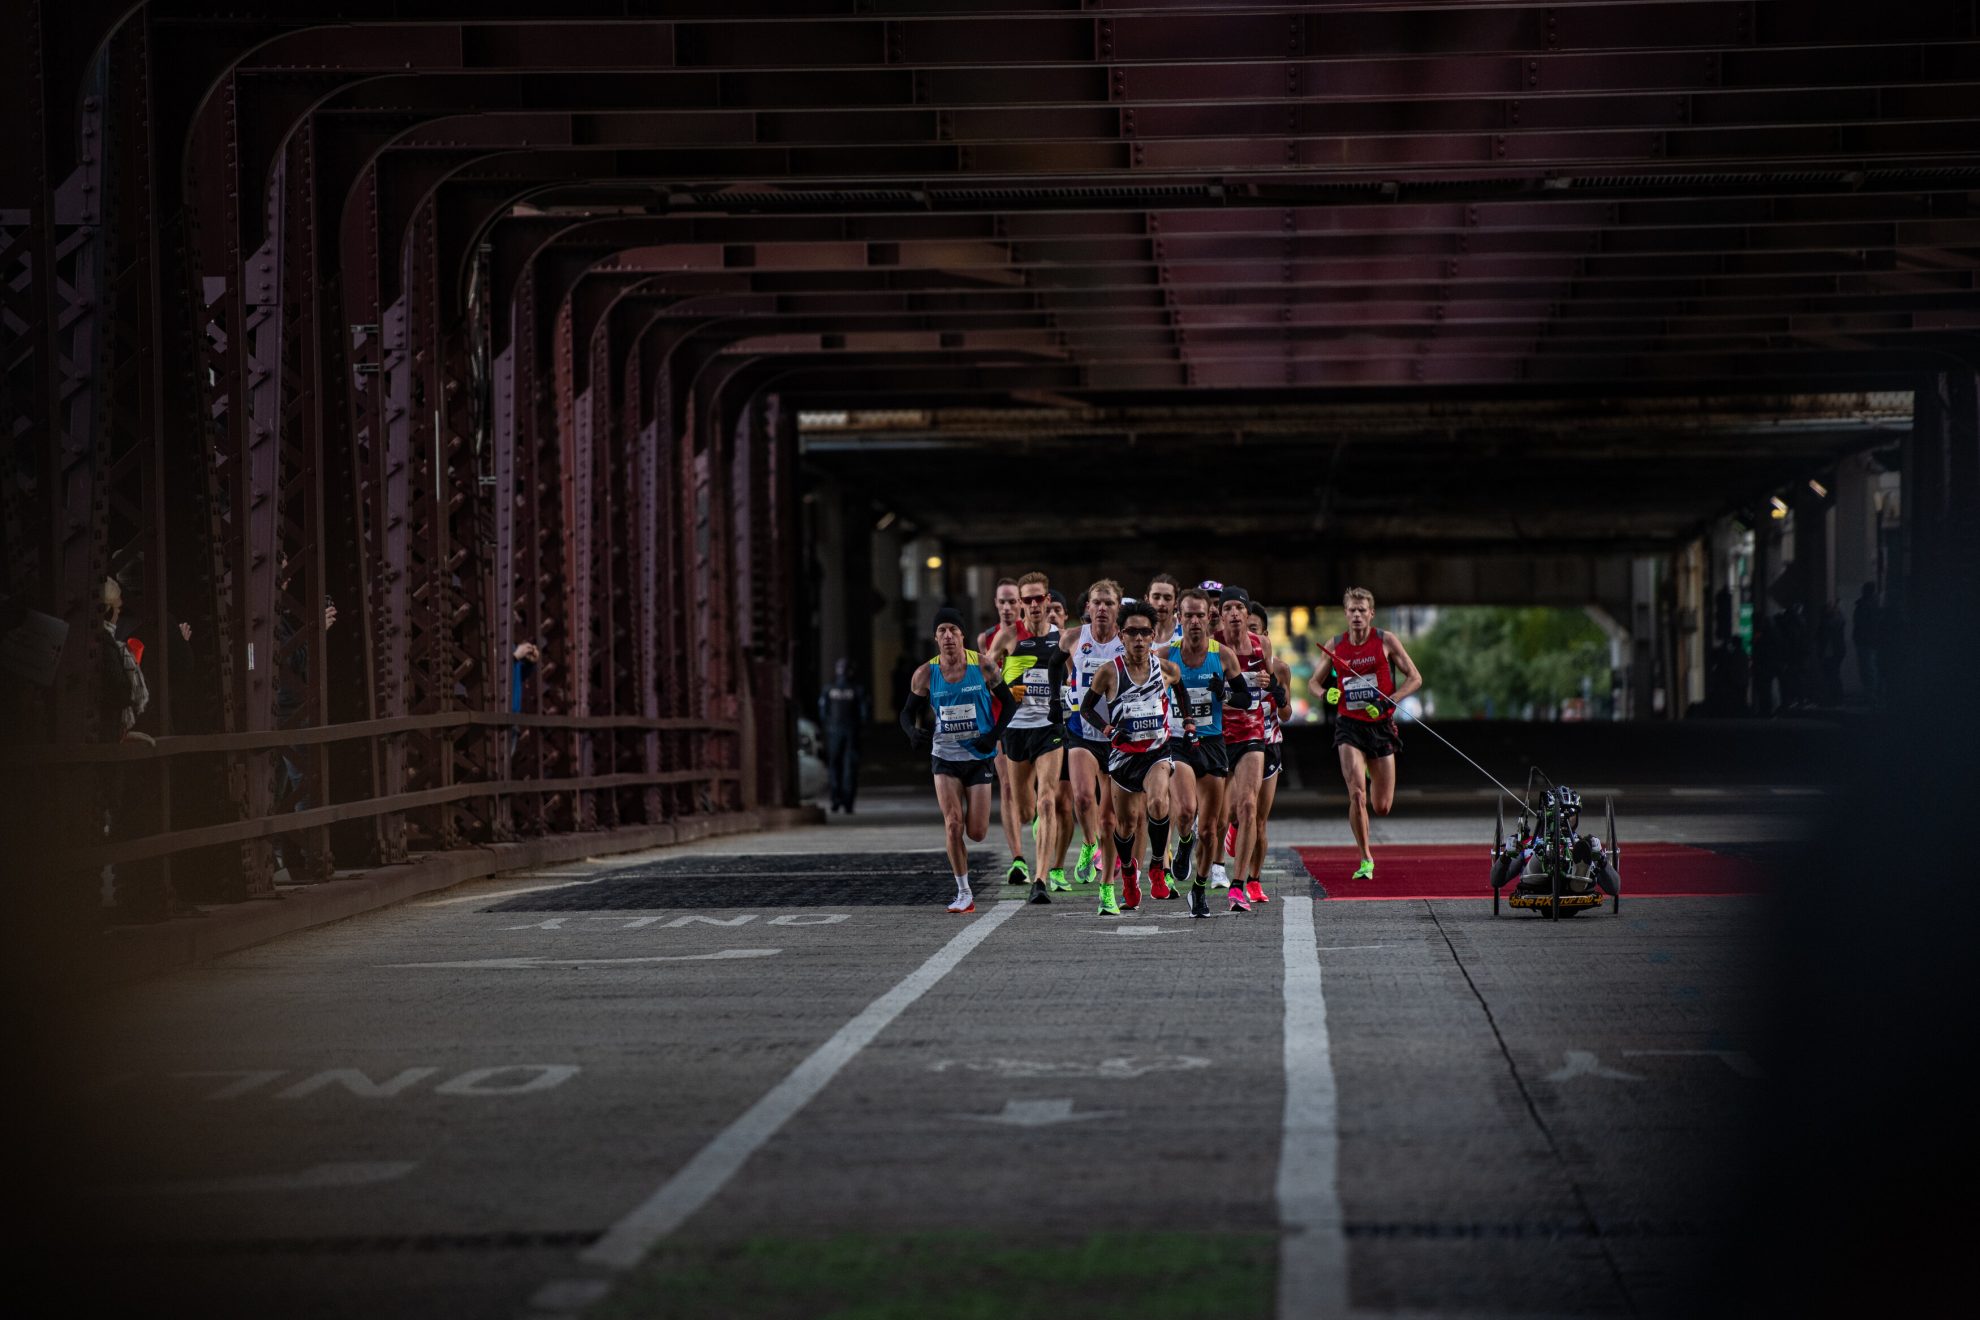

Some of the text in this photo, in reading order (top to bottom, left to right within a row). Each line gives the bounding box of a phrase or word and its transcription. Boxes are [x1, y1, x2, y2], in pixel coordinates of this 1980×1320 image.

[1352, 656, 1376, 665] ATLANTA
[1026, 685, 1051, 695] GREG
[1349, 690, 1374, 701] GIVEN
[1204, 705, 1211, 715] 3
[944, 721, 974, 732] SMITH
[1132, 718, 1159, 730] OISHI
[500, 913, 853, 931] ONLY
